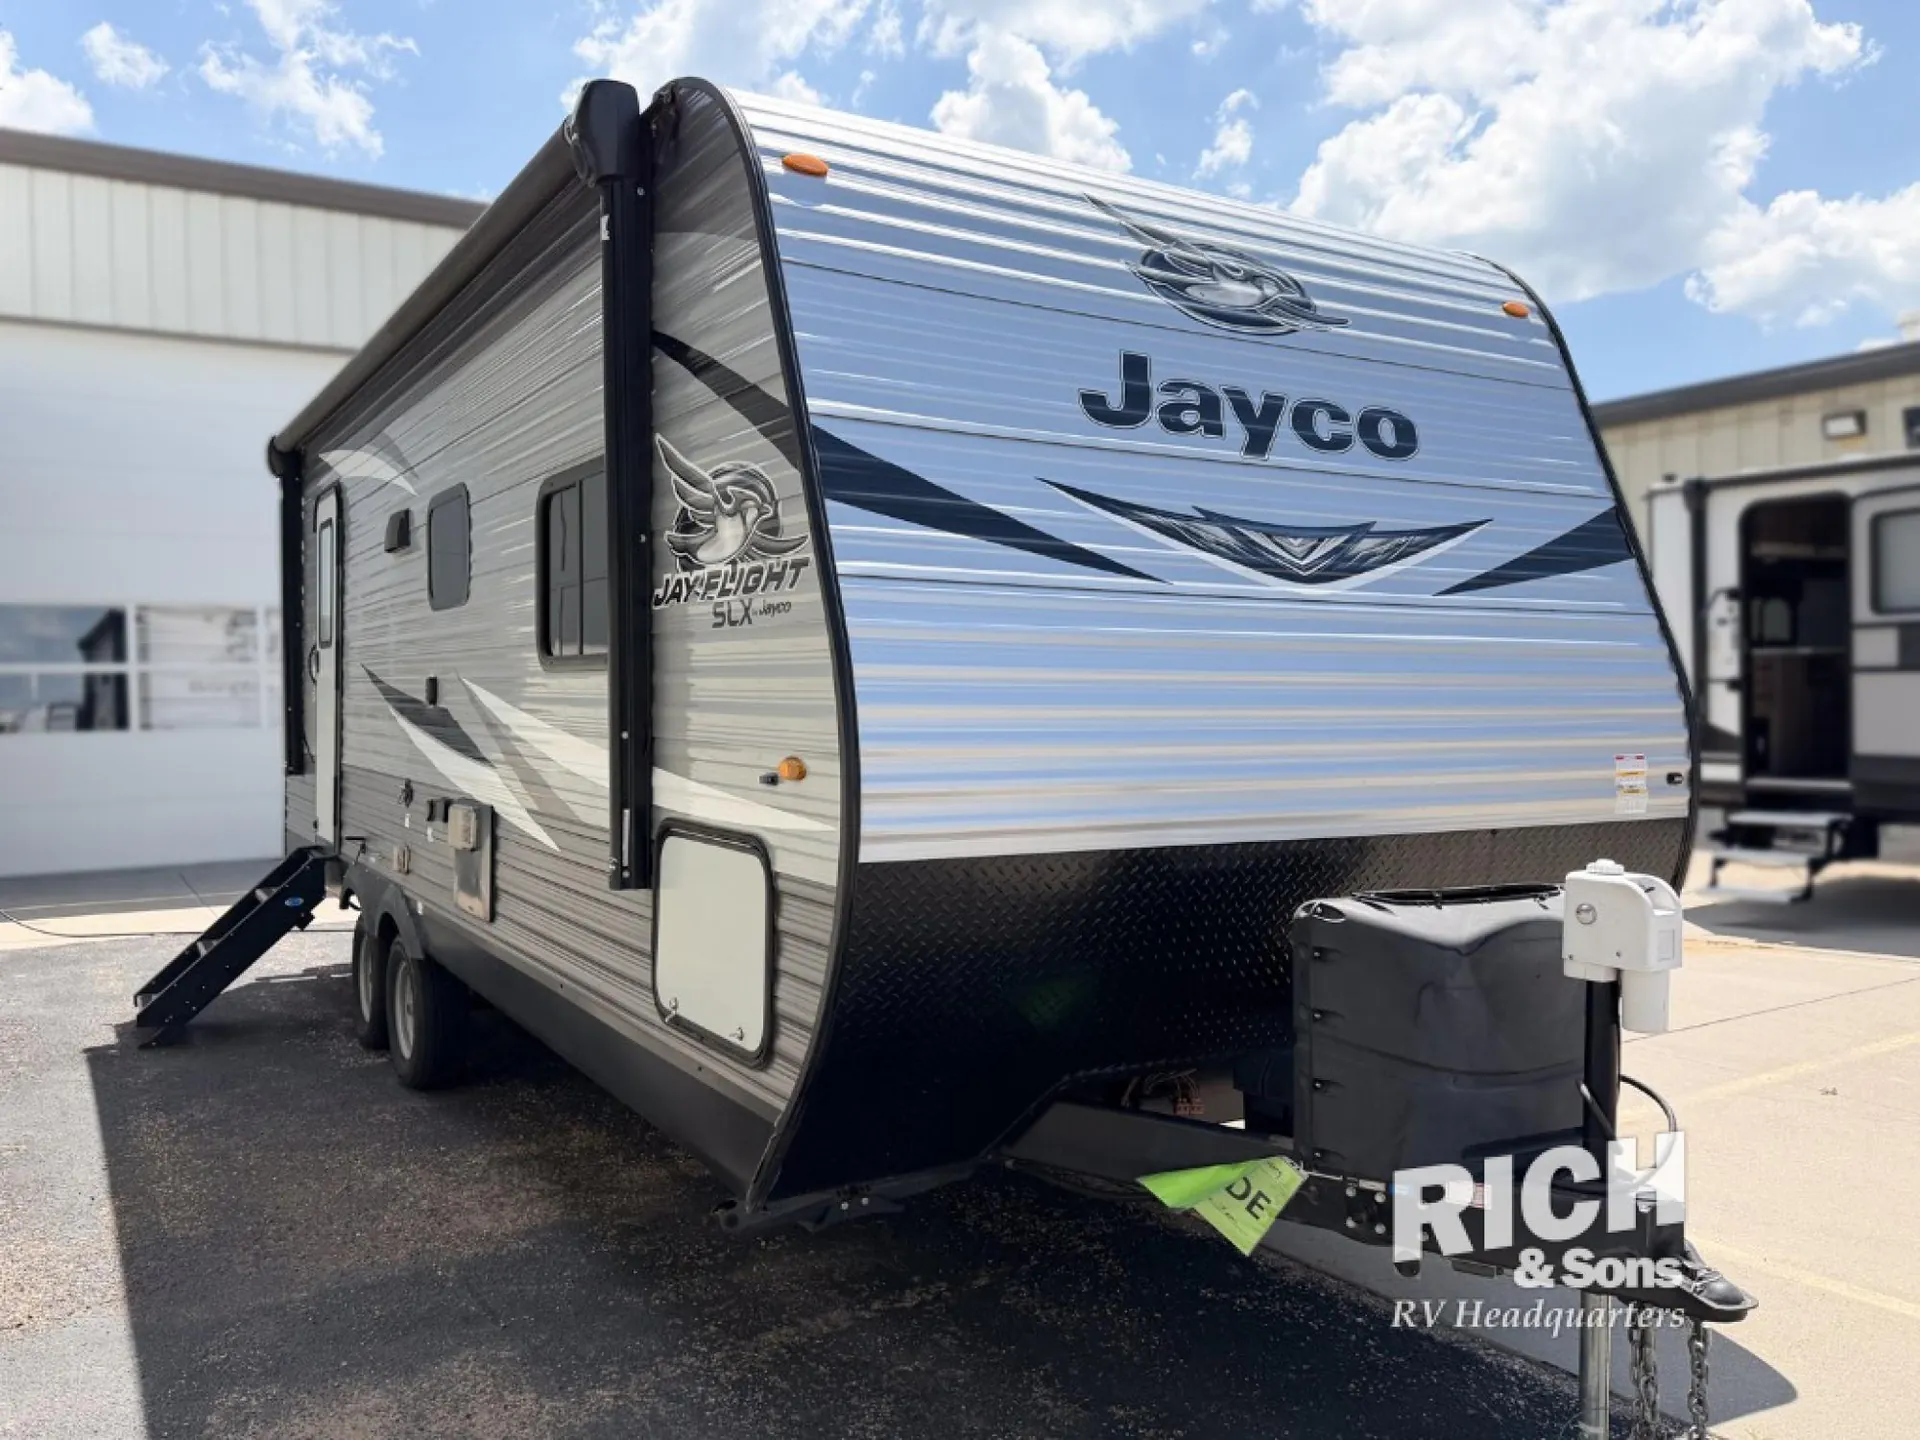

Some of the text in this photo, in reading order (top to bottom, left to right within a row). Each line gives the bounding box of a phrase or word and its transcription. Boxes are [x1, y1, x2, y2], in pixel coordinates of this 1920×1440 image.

[1078, 349, 1419, 460] Jayco
[653, 556, 811, 609] JAY FLIGHT
[712, 598, 752, 628] SLX
